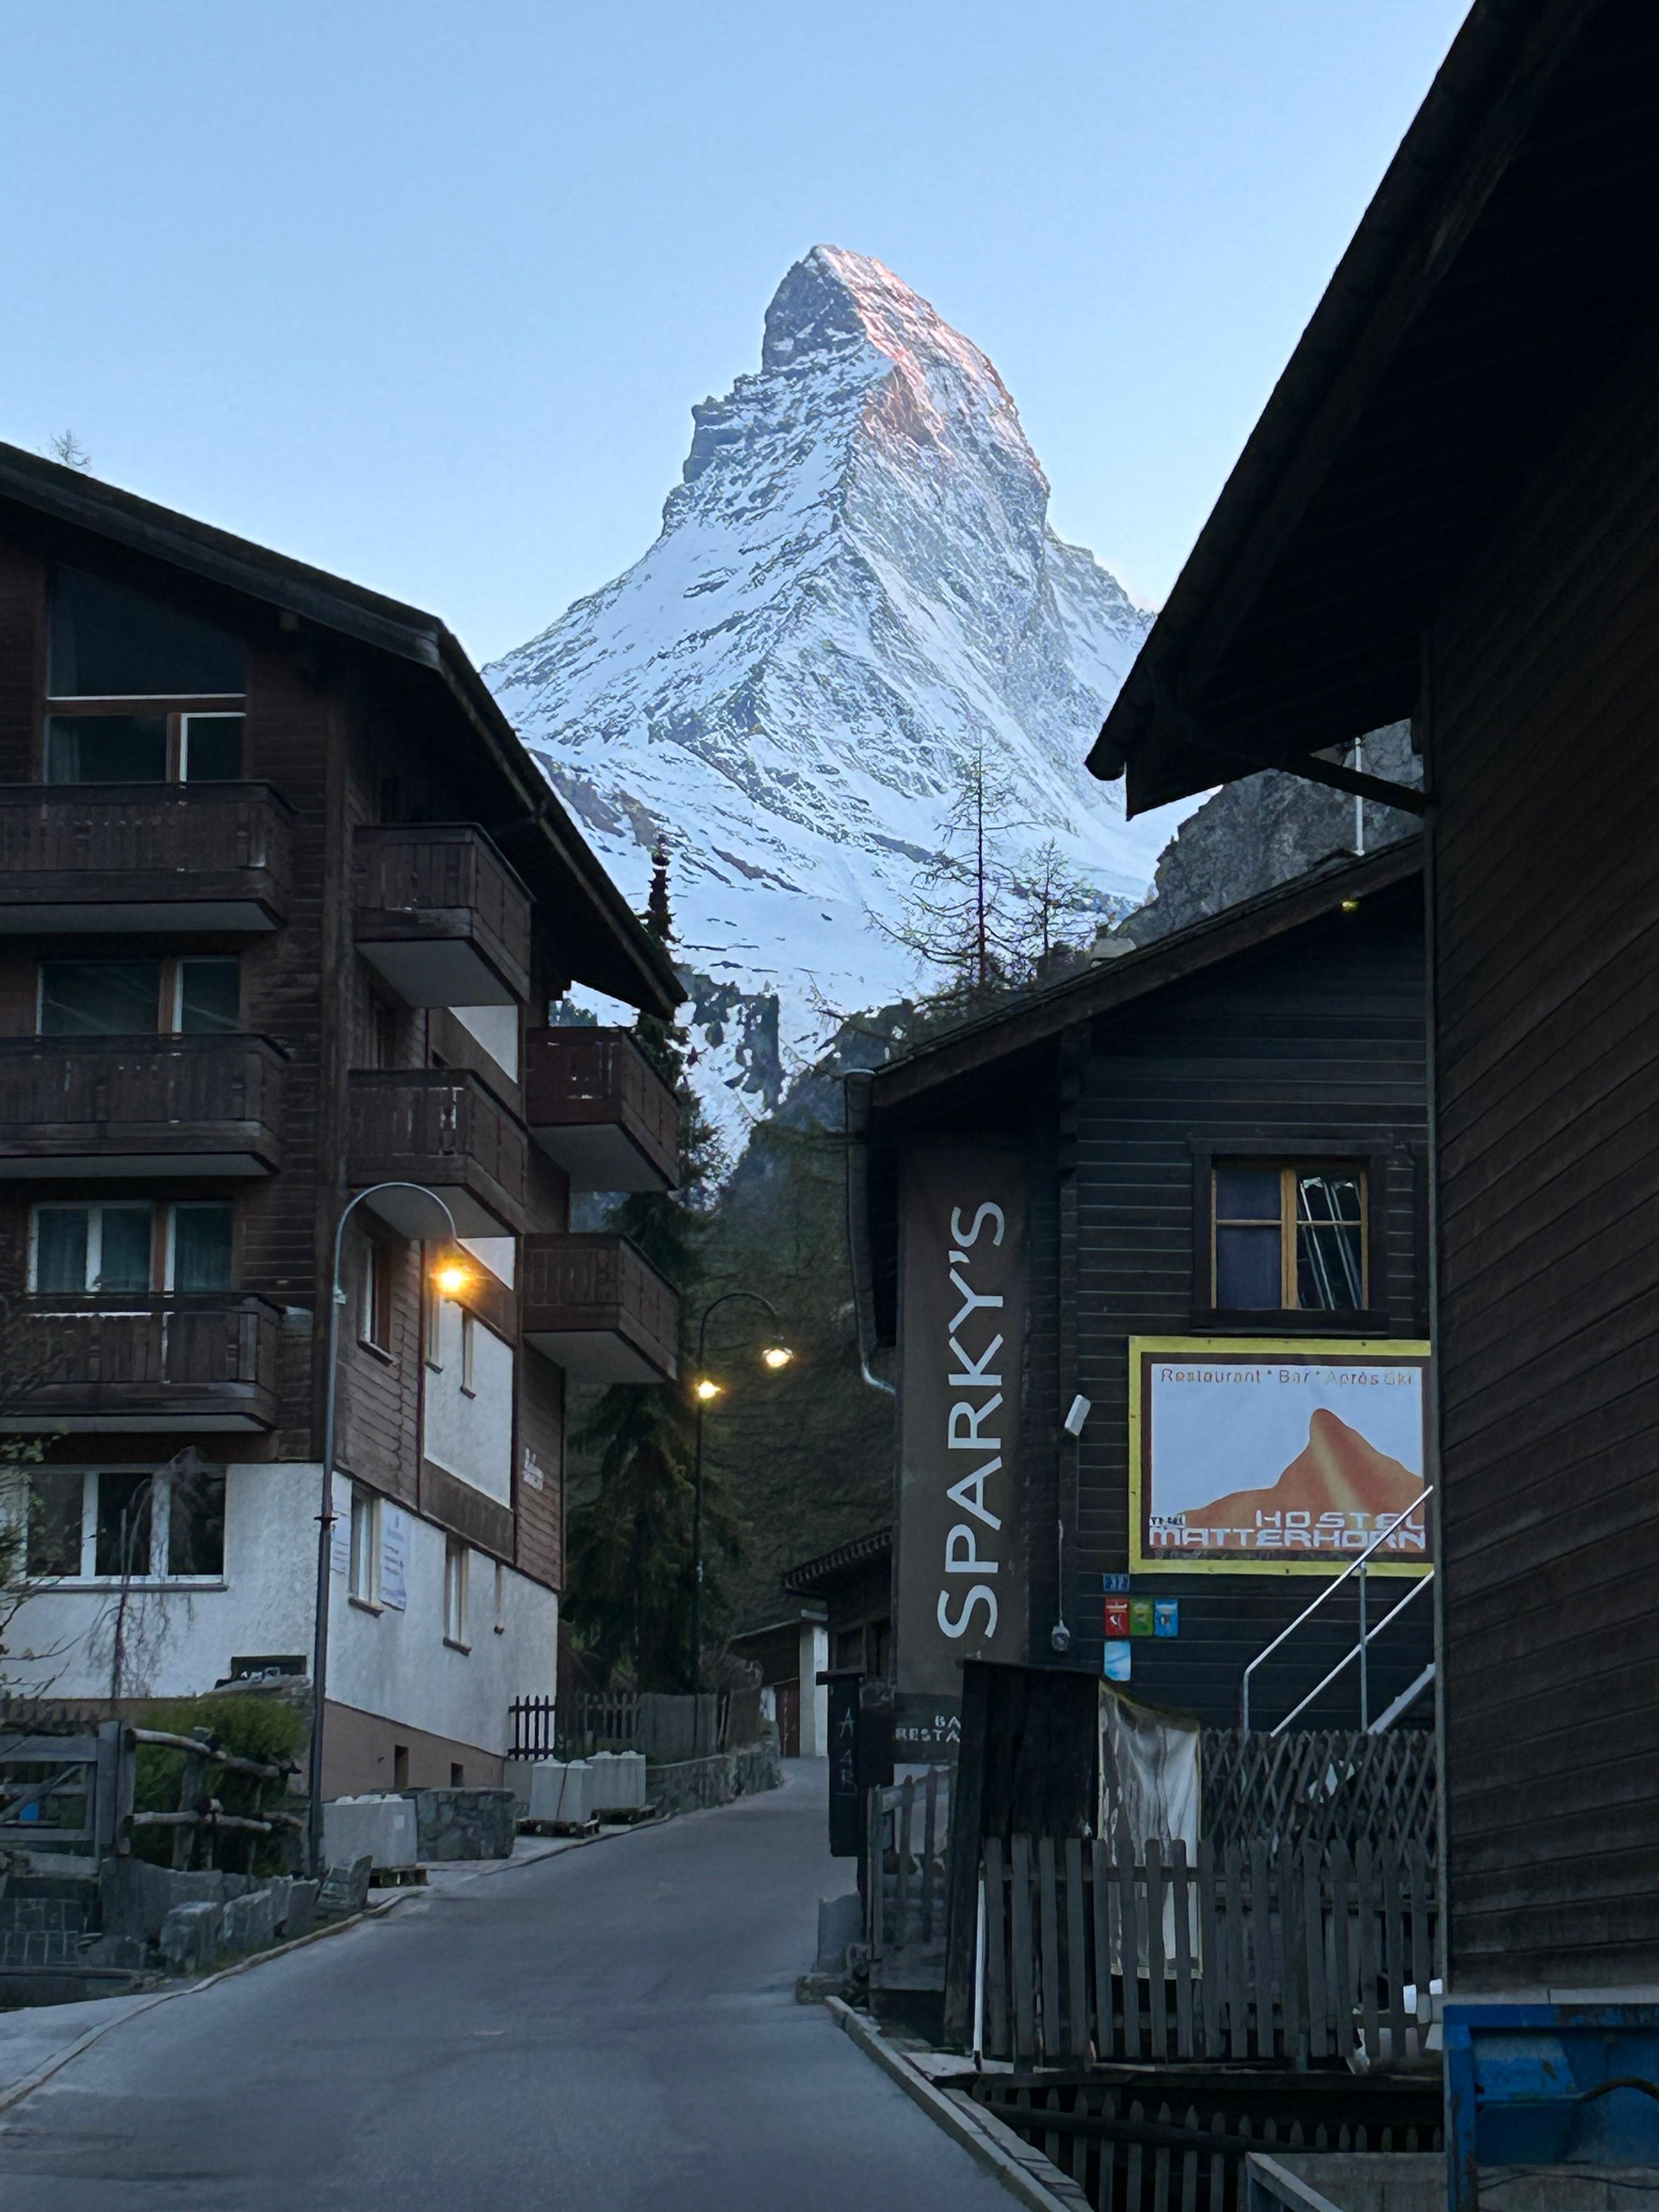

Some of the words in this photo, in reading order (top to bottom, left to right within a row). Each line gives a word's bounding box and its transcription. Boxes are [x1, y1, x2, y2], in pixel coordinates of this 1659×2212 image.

[1161, 1368, 1261, 1384] Restaurant
[1279, 1369, 1311, 1384] Bar
[937, 1201, 1005, 1638] SPARKY'S
[1256, 1509, 1425, 1530] HOSTEL
[1149, 1527, 1425, 1549] MATTERHORN
[934, 1715, 961, 1729] BA
[895, 1728, 961, 1743] RESTA
